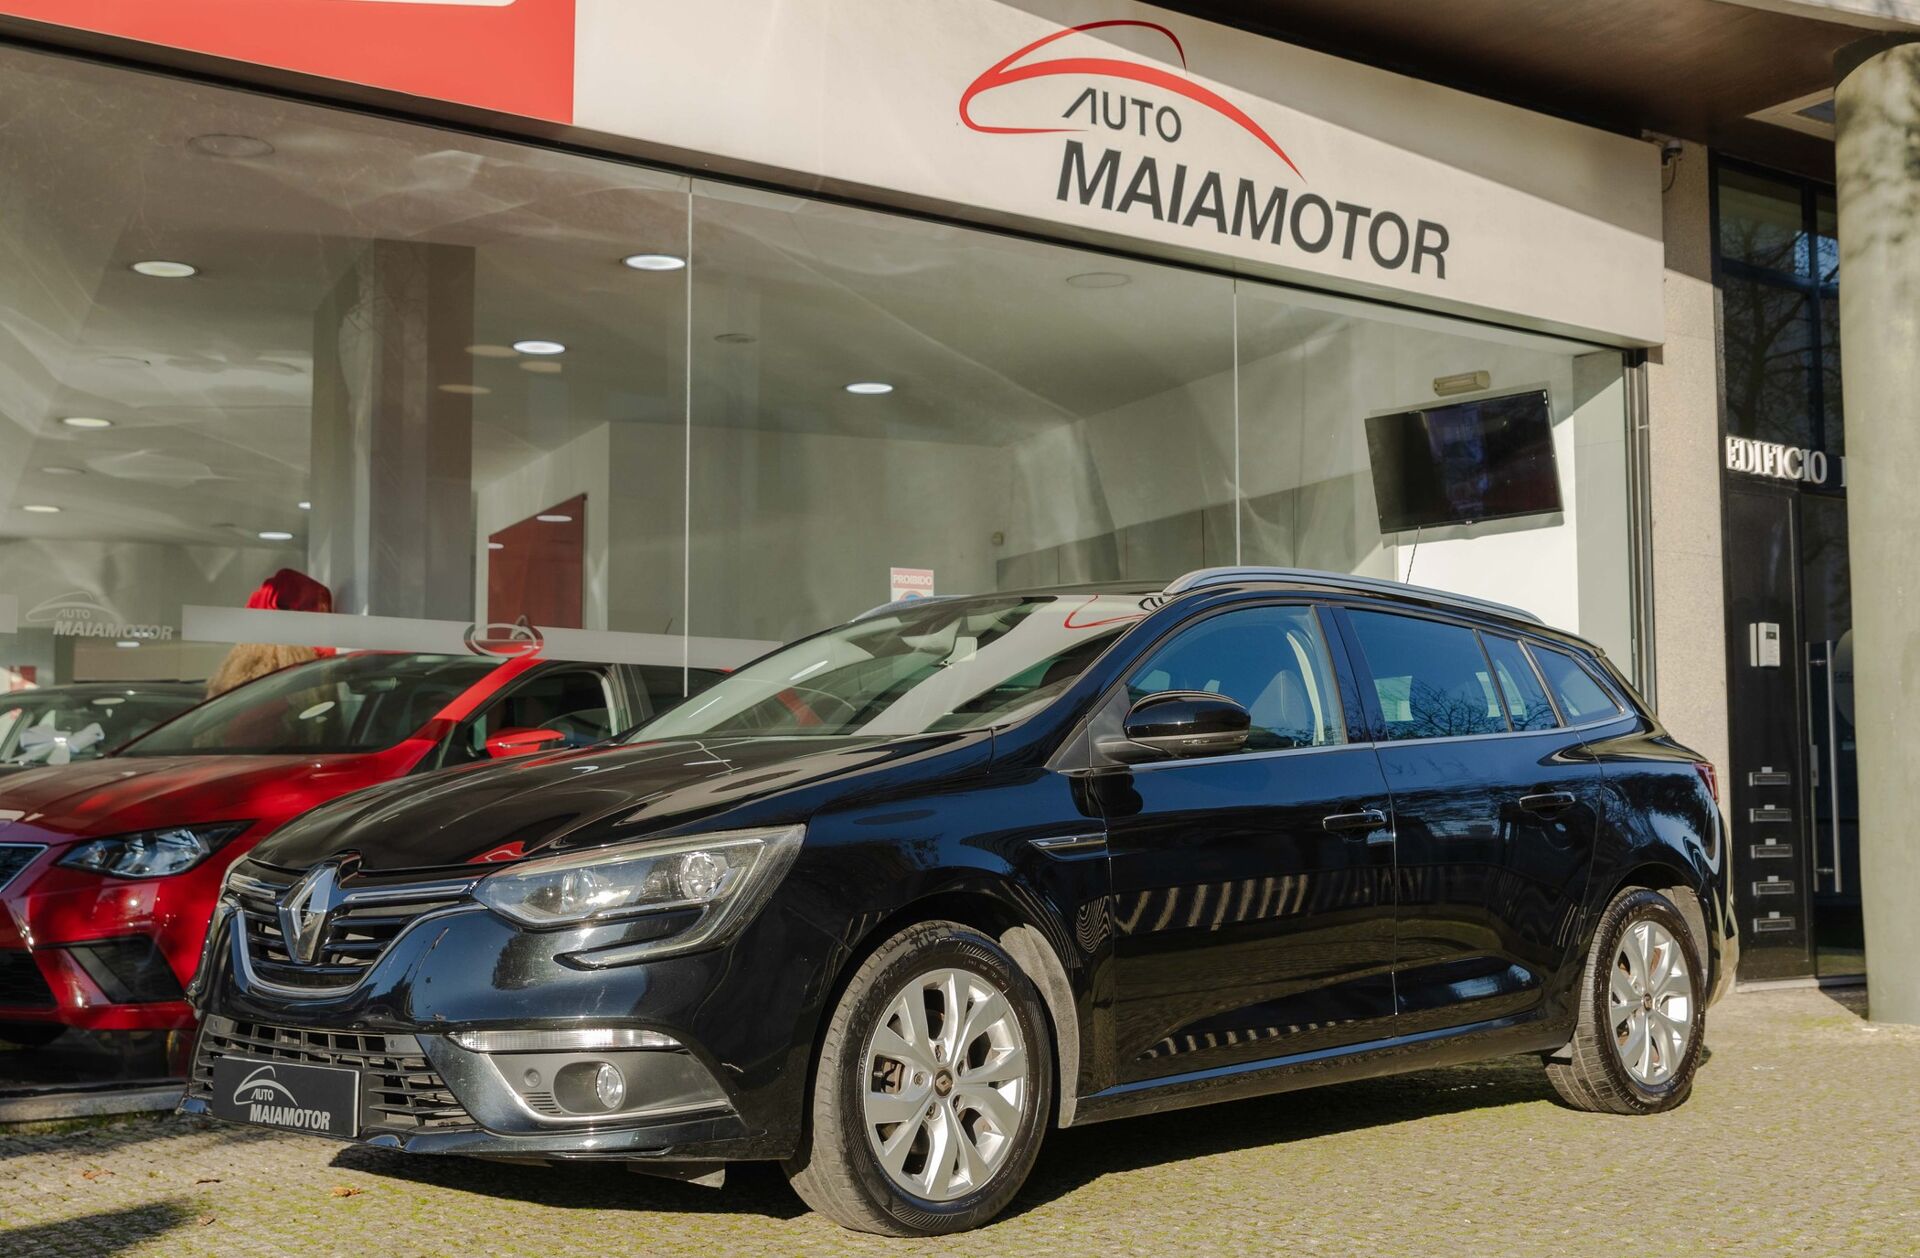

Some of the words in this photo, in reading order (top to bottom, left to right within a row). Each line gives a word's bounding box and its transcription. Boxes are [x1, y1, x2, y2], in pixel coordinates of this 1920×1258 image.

[1061, 87, 1182, 143] AUTO
[1056, 139, 1450, 280] MAIAMOTOR
[1726, 435, 1827, 484] EDIFICIO
[893, 574, 933, 586] PROIBIDO
[55, 608, 90, 619] AUTO
[53, 620, 174, 641] MAIAMOTOR
[251, 1088, 274, 1101] AUTO
[250, 1104, 331, 1130] MAIAMOTOR
